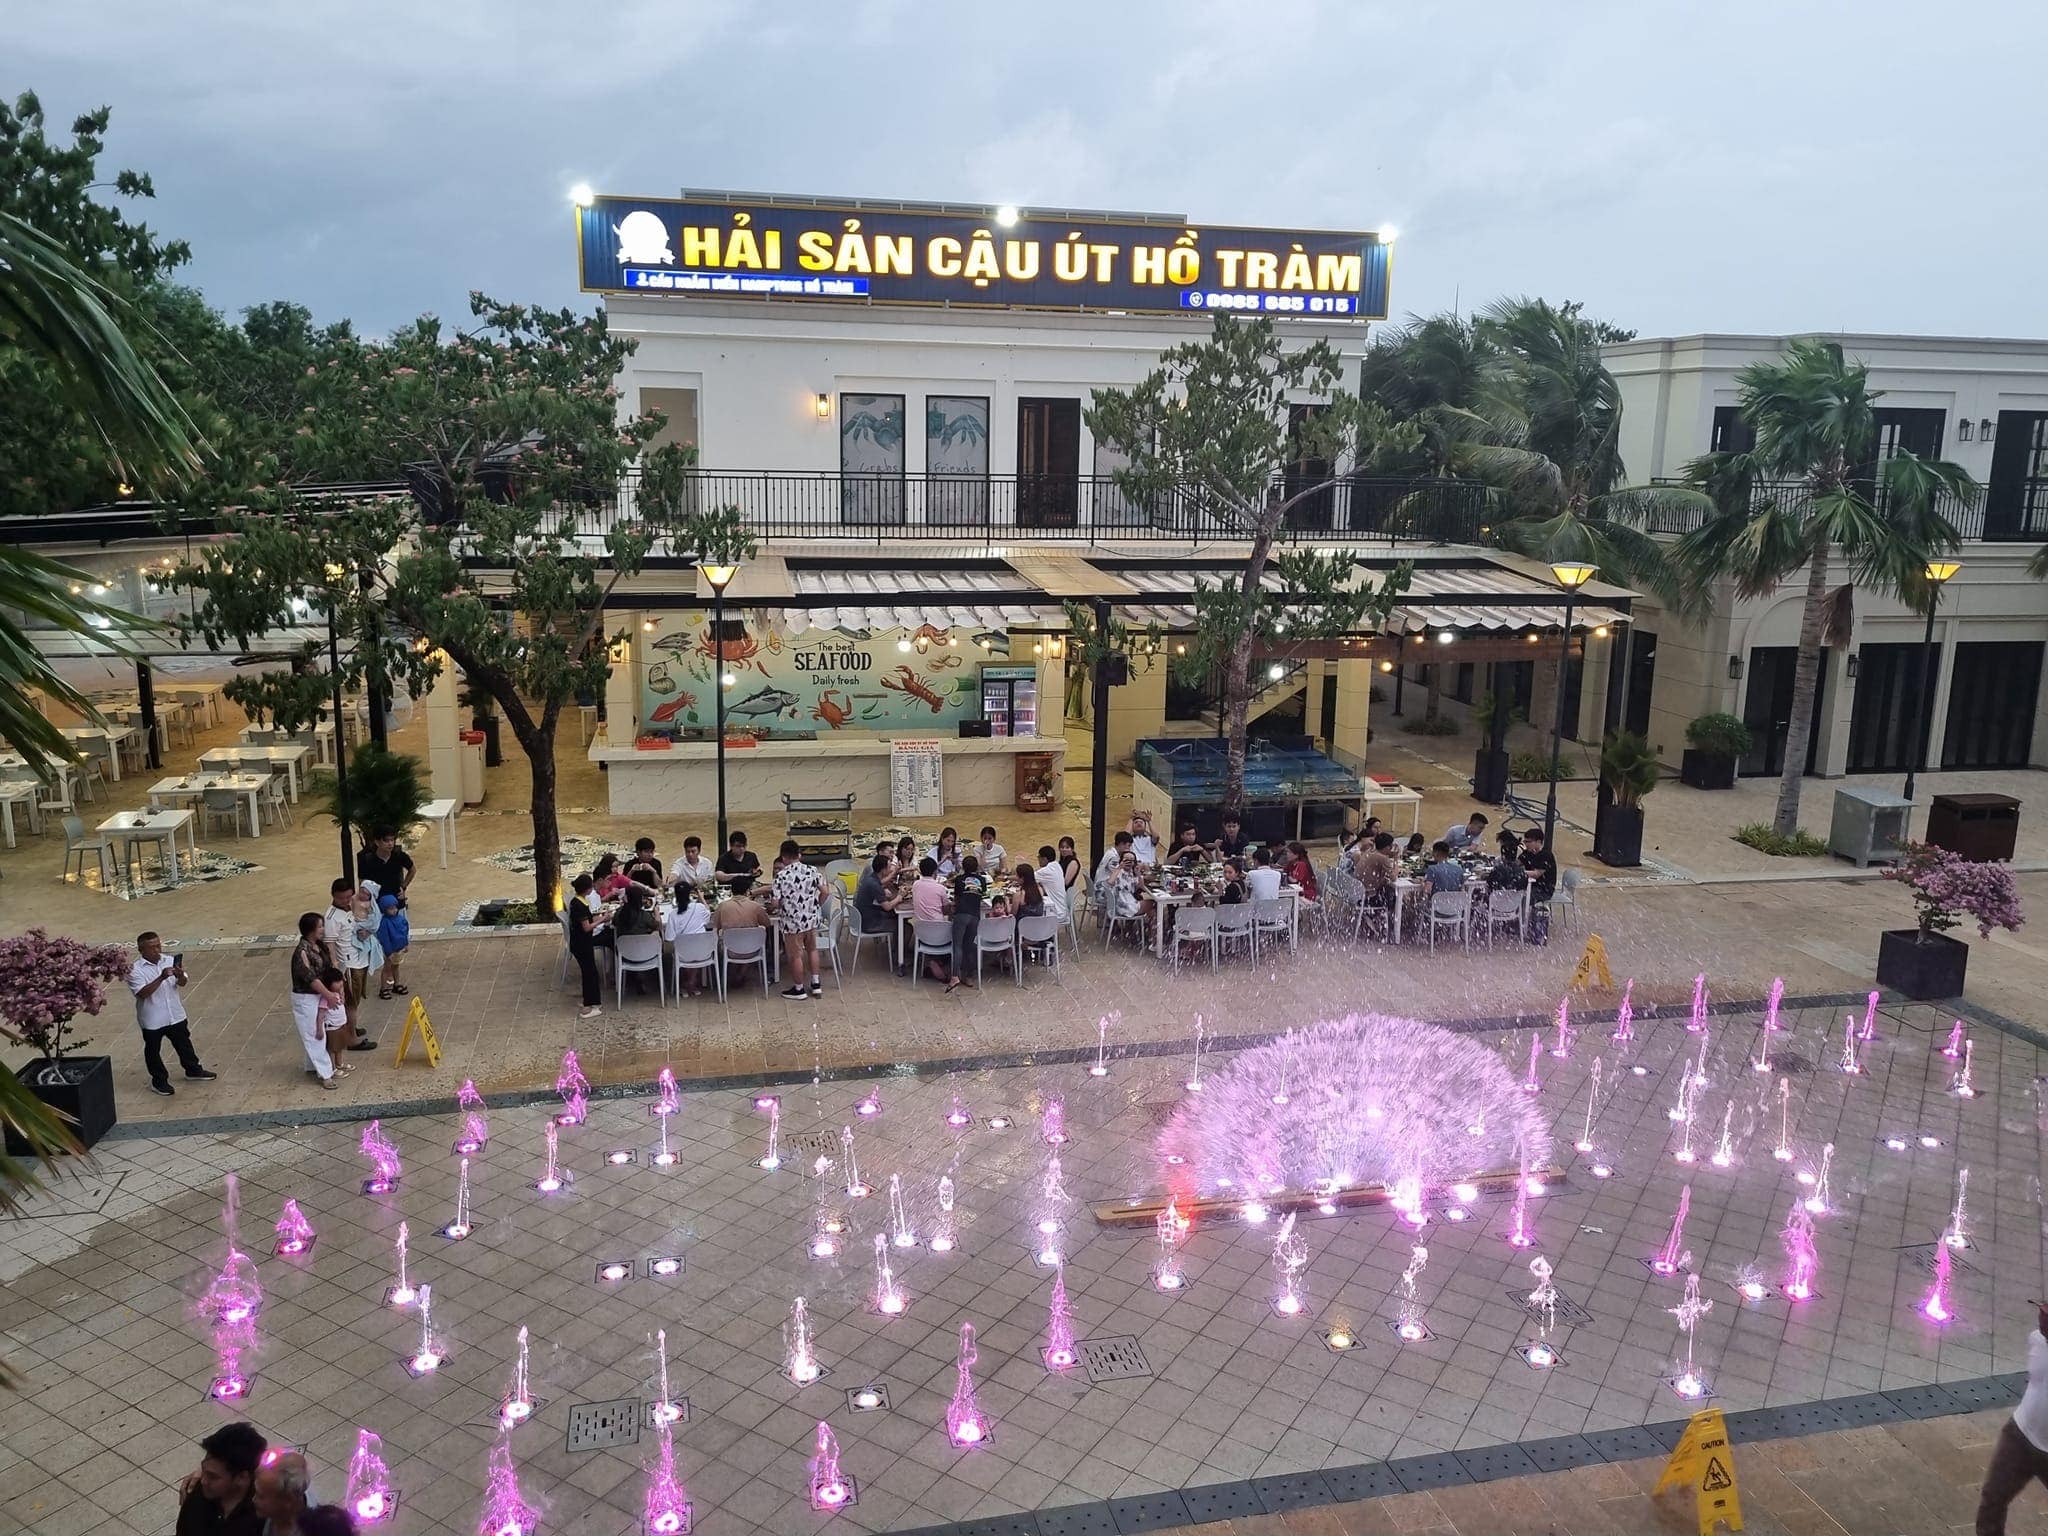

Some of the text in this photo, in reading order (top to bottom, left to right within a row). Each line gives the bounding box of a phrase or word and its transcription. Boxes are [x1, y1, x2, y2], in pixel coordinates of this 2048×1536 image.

[683, 212, 1361, 292] HẢI SẢN CẬU ÚT HỒ TRÀM
[819, 642, 855, 652] The best
[794, 652, 872, 671] SEAFOOD
[813, 674, 860, 688] Daily fresh
[1701, 1439, 1725, 1450] CAUTION
